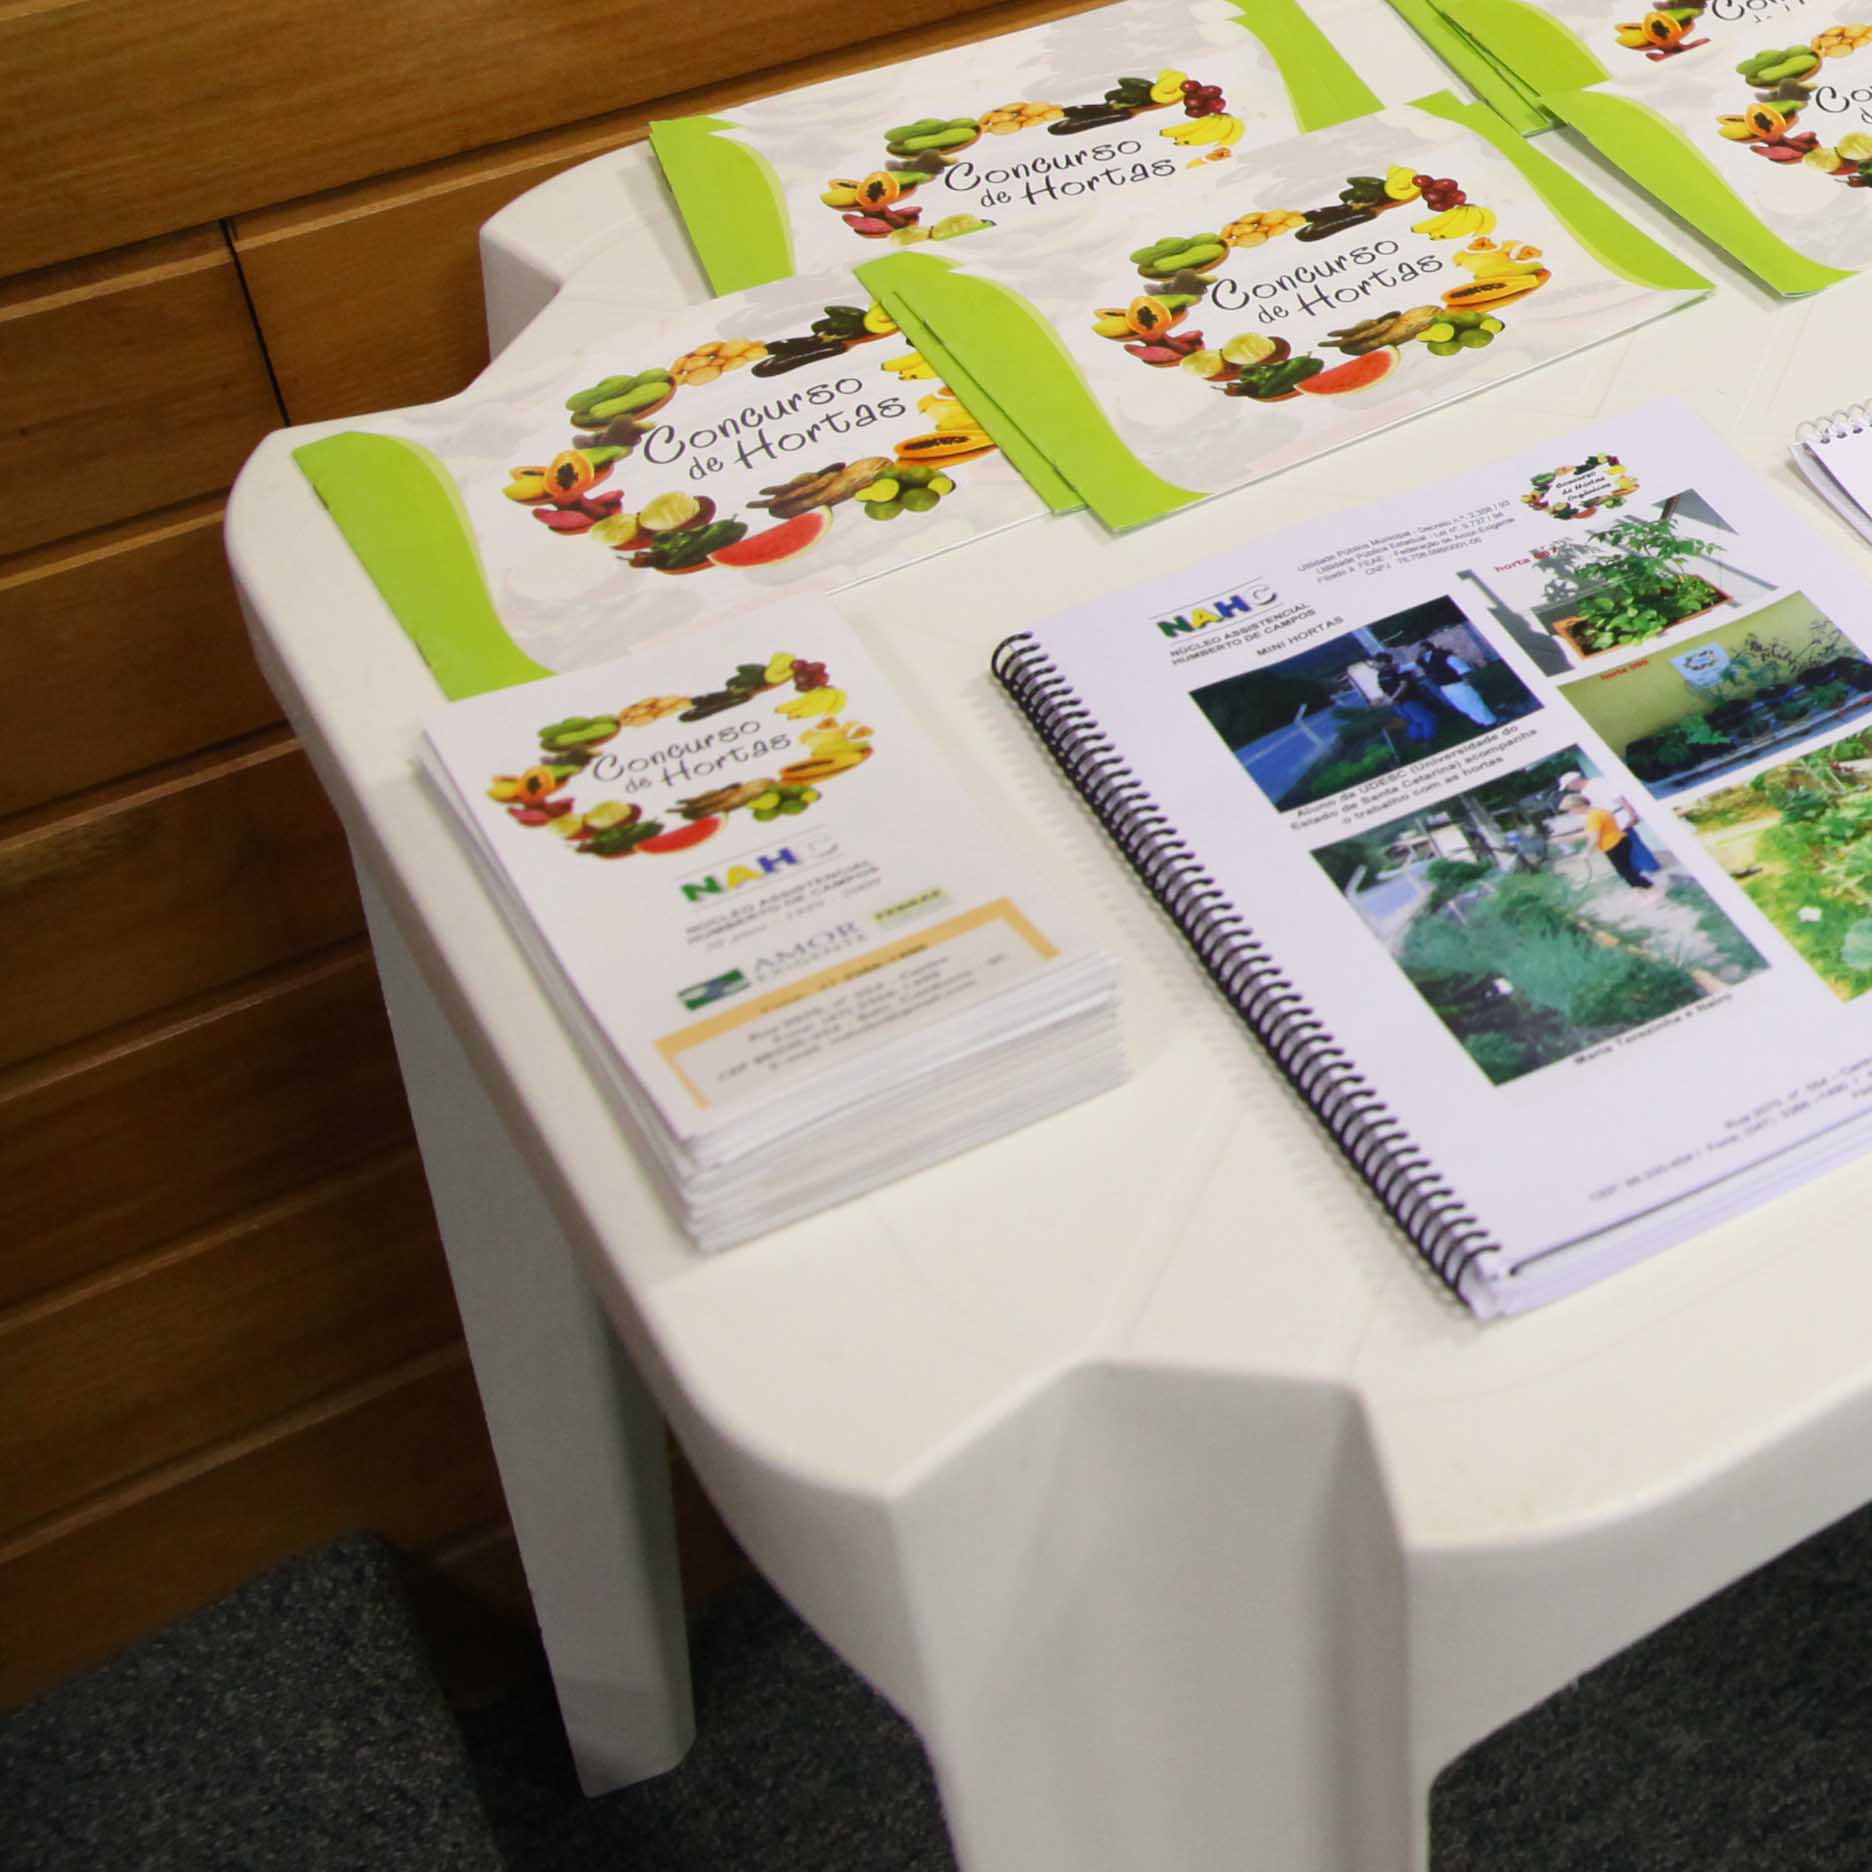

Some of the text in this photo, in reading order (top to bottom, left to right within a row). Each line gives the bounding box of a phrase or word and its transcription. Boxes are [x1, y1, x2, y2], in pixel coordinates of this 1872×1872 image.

[942, 138, 1142, 193] Concurso
[979, 155, 1176, 209] de Hortas
[1210, 237, 1401, 311] Concurso
[1257, 251, 1444, 325] de Hortas
[640, 373, 864, 466] Concurso
[687, 393, 907, 482] de Hortas
[1243, 630, 1262, 644] DE
[1265, 608, 1317, 636] CAMPOS
[1255, 615, 1346, 658] MINI HORTAS
[591, 720, 760, 782] Concurso
[623, 732, 791, 794] de Hortas
